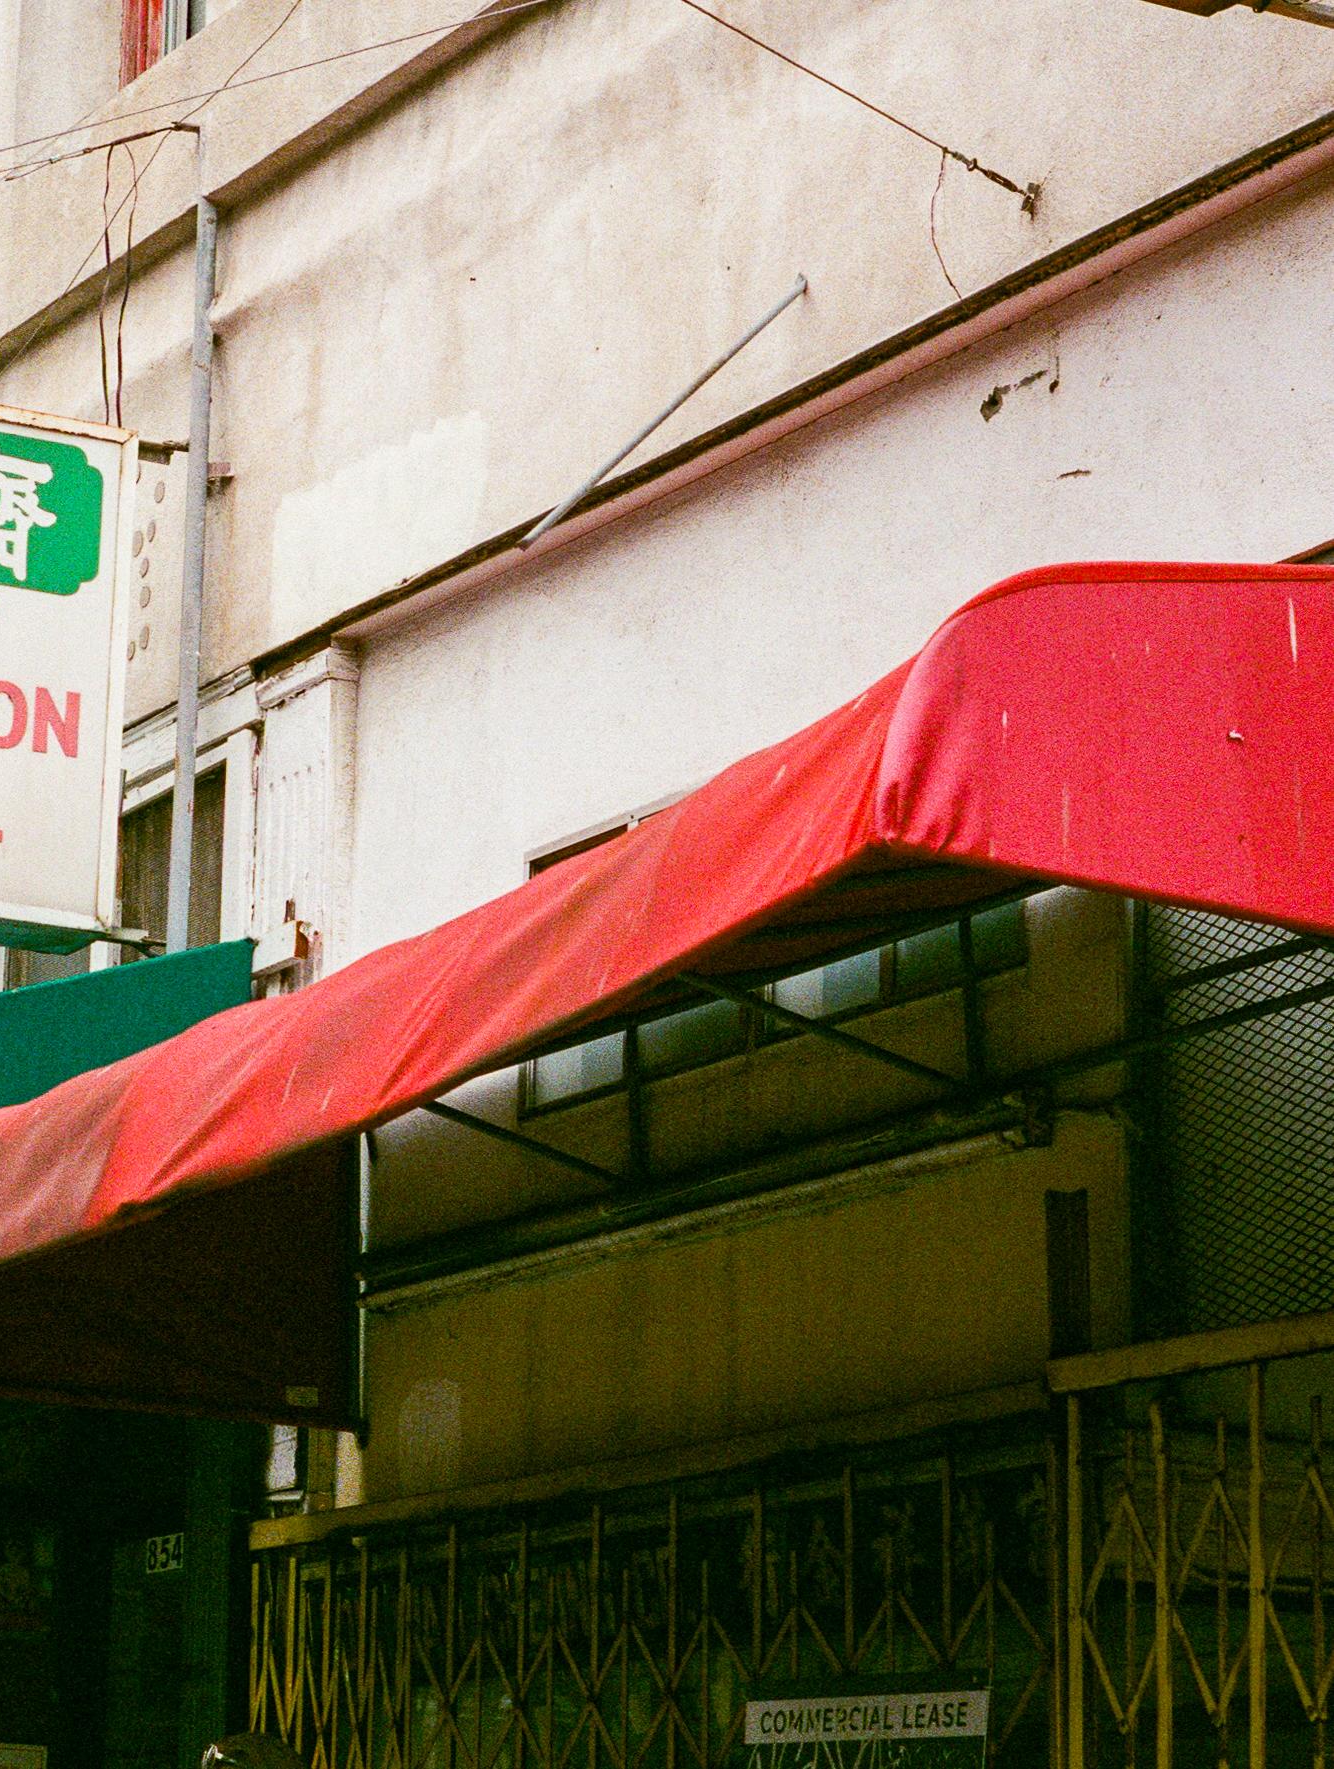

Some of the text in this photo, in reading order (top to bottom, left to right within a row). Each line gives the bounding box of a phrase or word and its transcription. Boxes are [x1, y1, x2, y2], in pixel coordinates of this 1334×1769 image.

[148, 1535, 182, 1570] 854
[760, 1701, 968, 1736] COMMERCIAL LEASE
